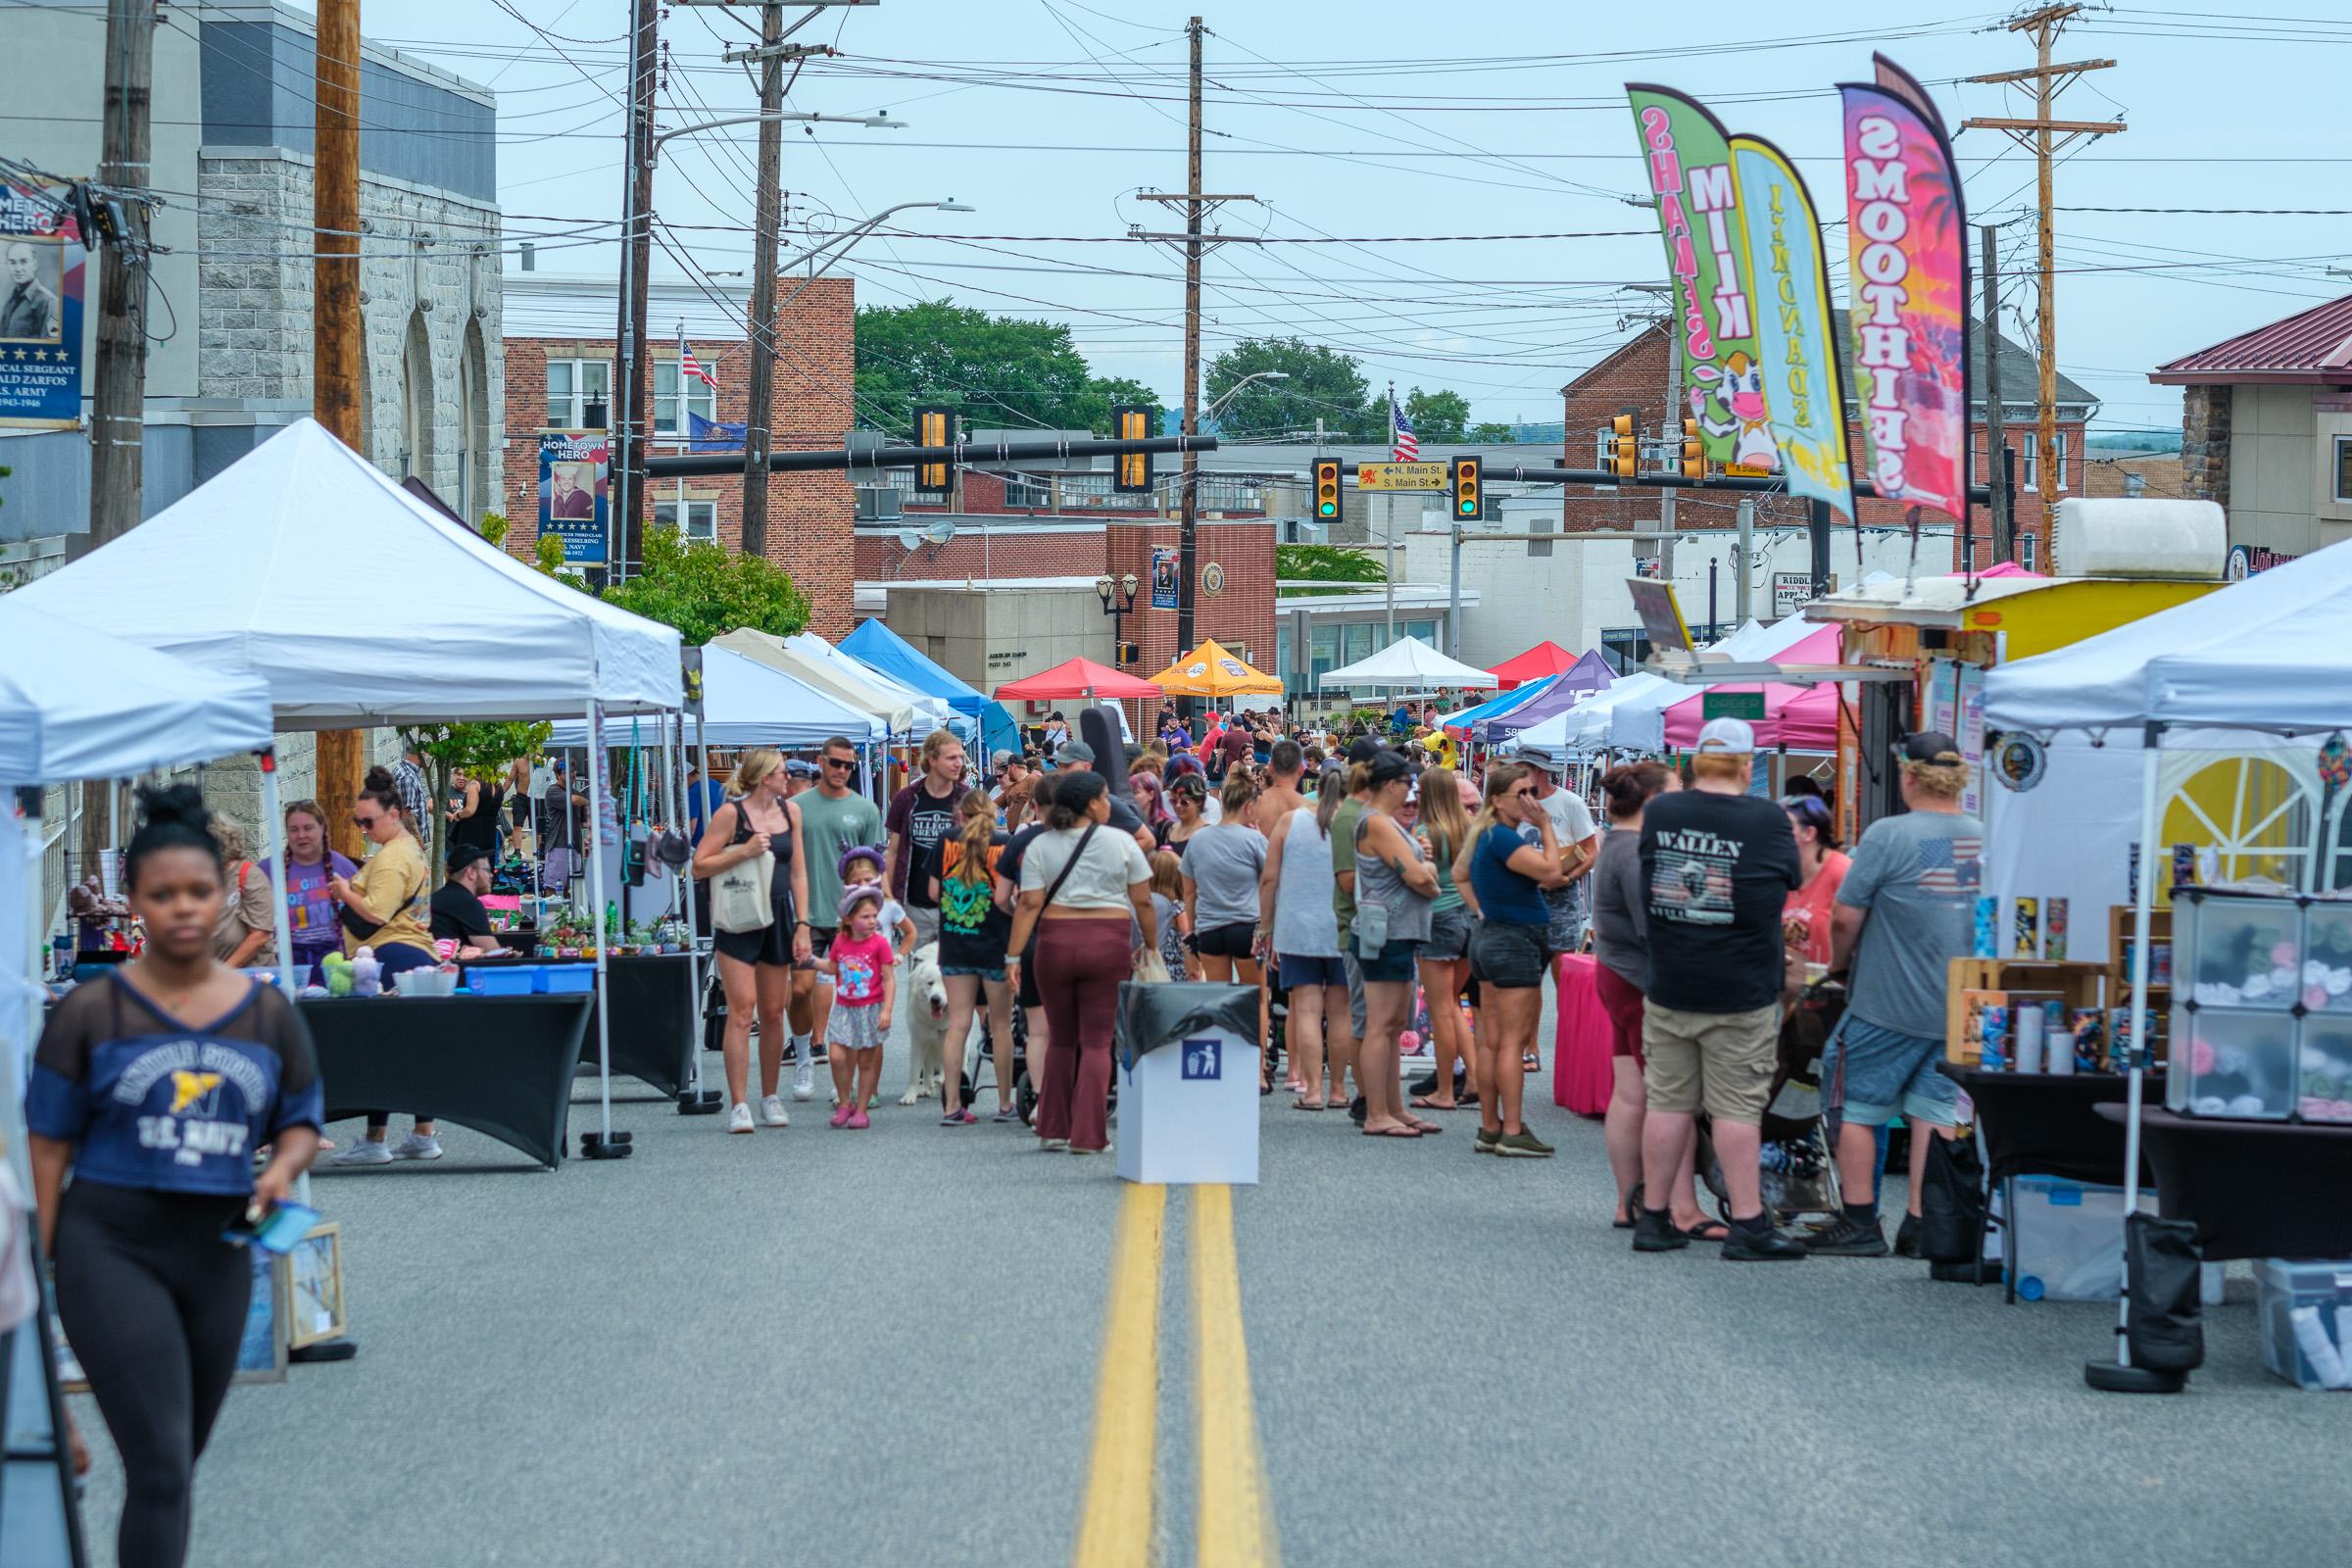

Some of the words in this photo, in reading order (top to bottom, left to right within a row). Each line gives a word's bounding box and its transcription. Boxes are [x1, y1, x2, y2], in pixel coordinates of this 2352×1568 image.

[23, 365, 76, 375] SERGEANT
[23, 375, 68, 386] ZARFOS
[14, 388, 48, 397] ARMY
[543, 441, 605, 450] HOMETOWN
[558, 450, 590, 460] HERO
[1420, 478, 1431, 486] St.
[1171, 665, 1204, 675] SOLAR
[1709, 698, 1761, 709] ORDER
[1656, 831, 1744, 858] WALLEN
